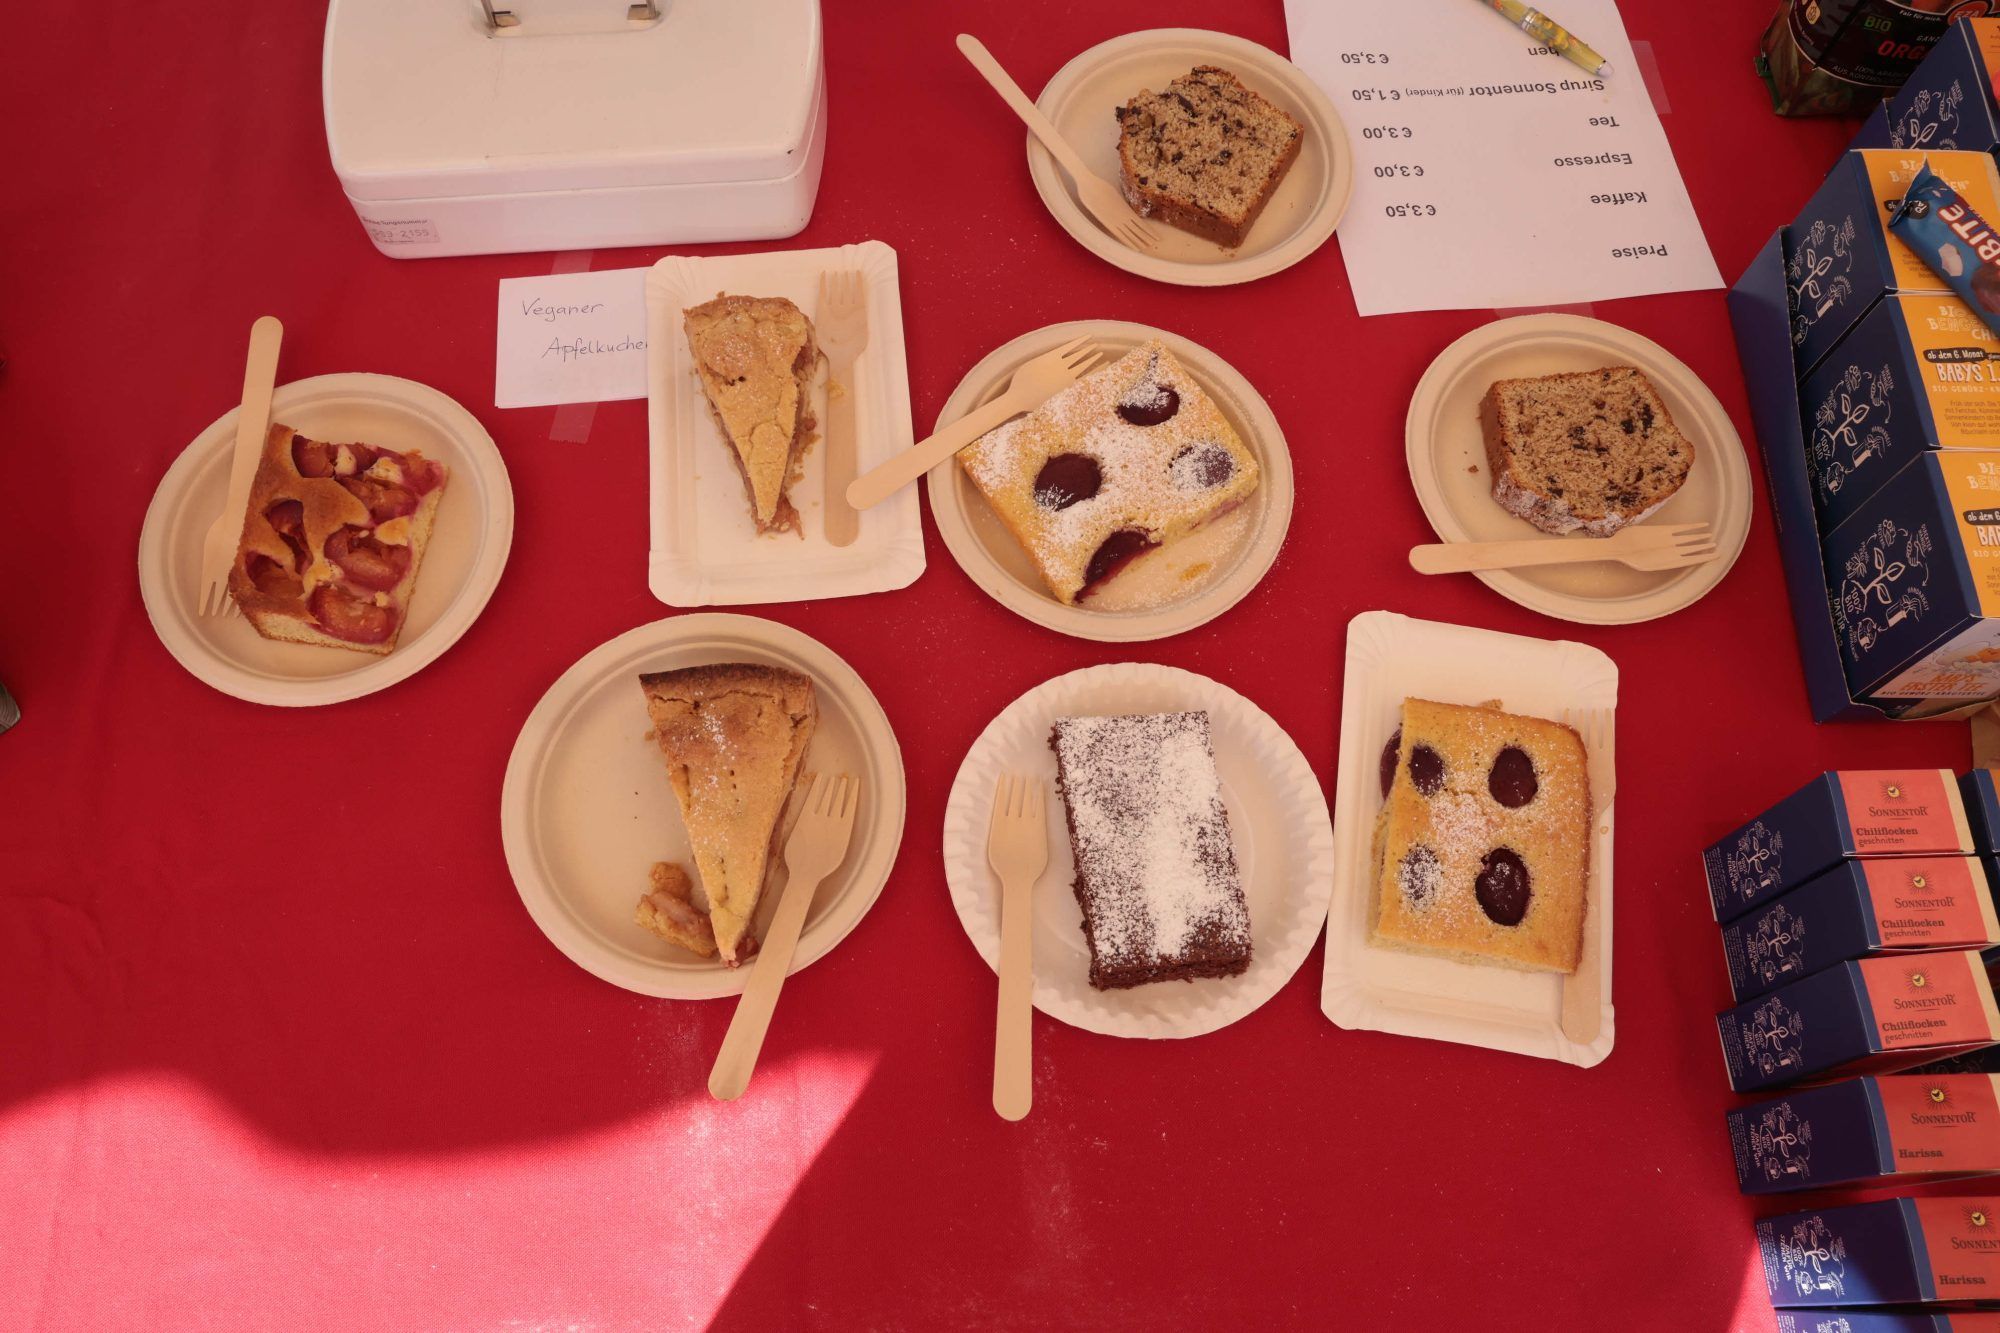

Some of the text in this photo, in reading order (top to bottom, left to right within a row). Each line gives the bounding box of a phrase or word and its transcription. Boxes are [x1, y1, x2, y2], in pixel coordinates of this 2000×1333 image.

[1864, 15, 1894, 32] BIO
[1876, 40, 1927, 60] ORG
[1340, 51, 1377, 65] 3,50
[1379, 53, 1390, 65] €
[1351, 78, 1605, 101] Sirup Sonnentor (für Kinder) € 1,50
[1362, 116, 1620, 140] Tee € 3,00
[1373, 152, 1633, 178] Espresso € 3,00
[1385, 191, 1647, 218] Kaffee € 3,50
[1611, 243, 1668, 260] Preise
[522, 297, 604, 322] Veganer
[1928, 352, 1936, 360] ab
[1939, 351, 1952, 359] dem
[1962, 350, 1984, 359] Monat
[1936, 363, 1984, 382] BABYS
[1968, 513, 1978, 521] ab
[1845, 596, 1854, 613] BIO
[1853, 588, 1863, 615] 100%
[1833, 598, 1846, 631] DAFÜR
[1856, 827, 1918, 836] Chiliflocken
[1858, 836, 1905, 848] geschnitten
[1881, 919, 1945, 928] Chiliflocken
[1884, 929, 1932, 941] geschnitten
[1882, 1018, 1947, 1031] Chiliflocken
[1885, 1031, 1933, 1044] geschnitten
[1899, 1149, 1944, 1159] Harissa
[1939, 1275, 1986, 1285] Harissa
